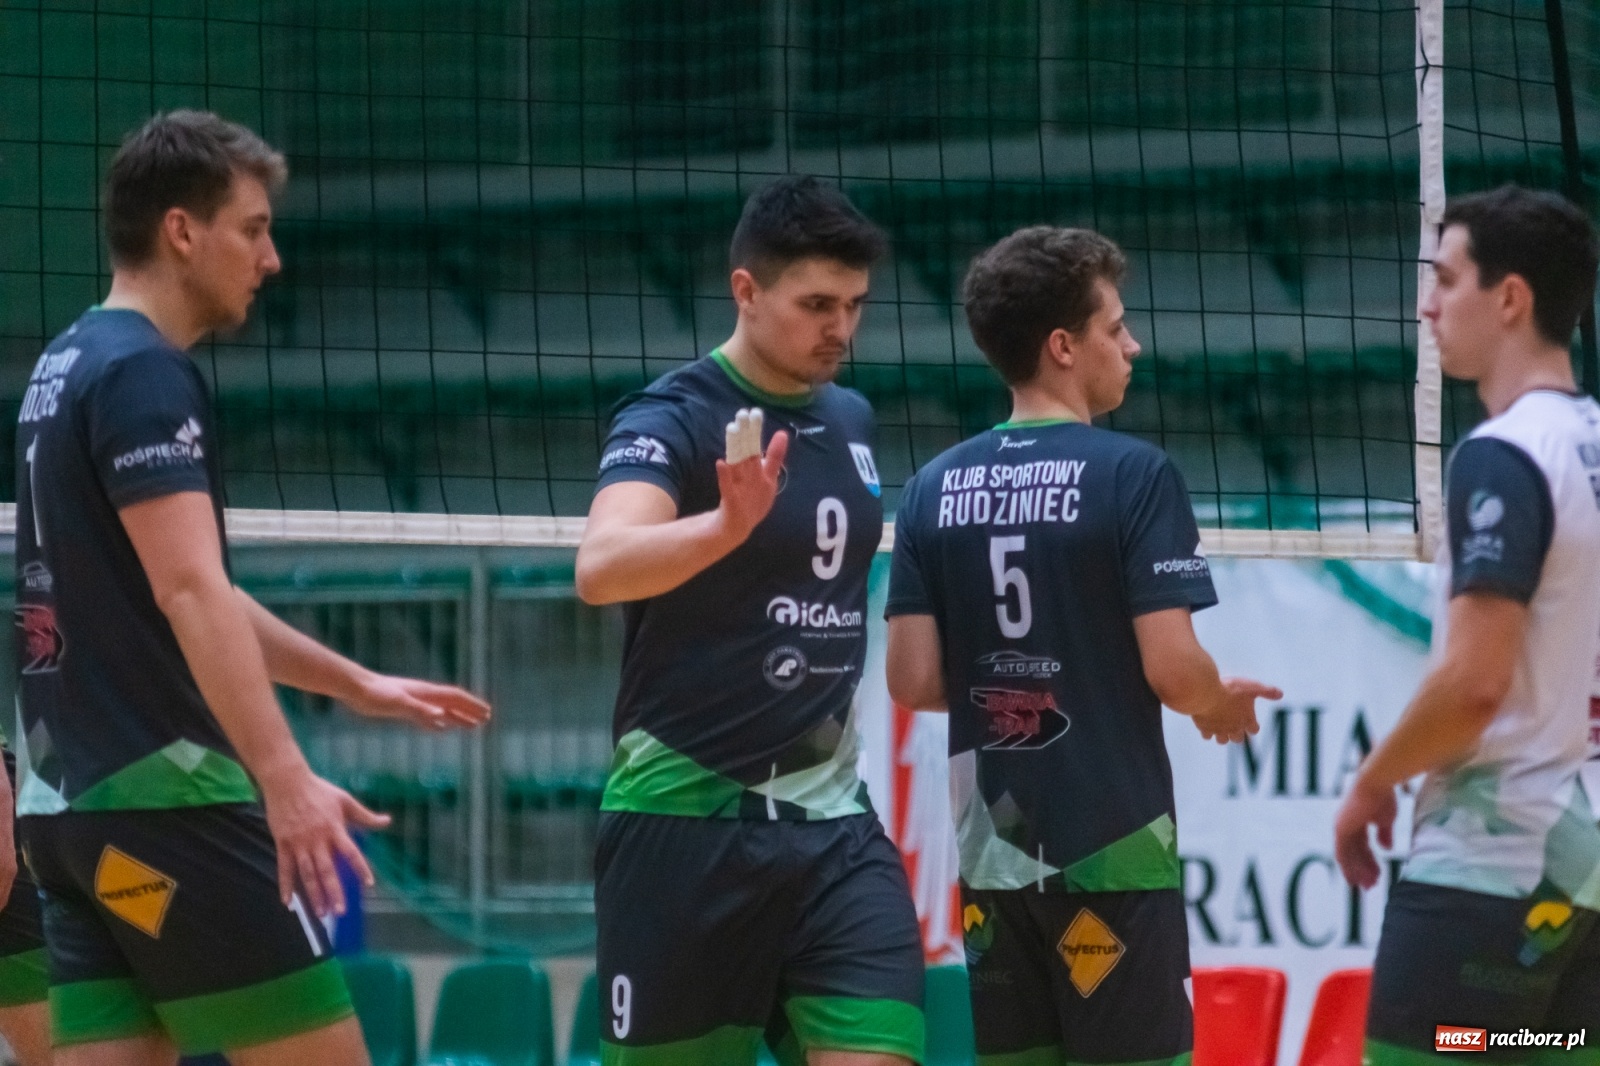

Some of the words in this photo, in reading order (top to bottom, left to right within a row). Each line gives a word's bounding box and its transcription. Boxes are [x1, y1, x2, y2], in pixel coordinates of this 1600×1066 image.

[942, 466, 986, 492] KLUB
[989, 460, 1086, 489] SPORTOWY
[938, 487, 1081, 528] RUDZINIEC
[812, 497, 848, 580] 9
[989, 535, 1033, 639] 5
[1153, 557, 1208, 575] POŚPIECH
[611, 973, 632, 1040] 9
